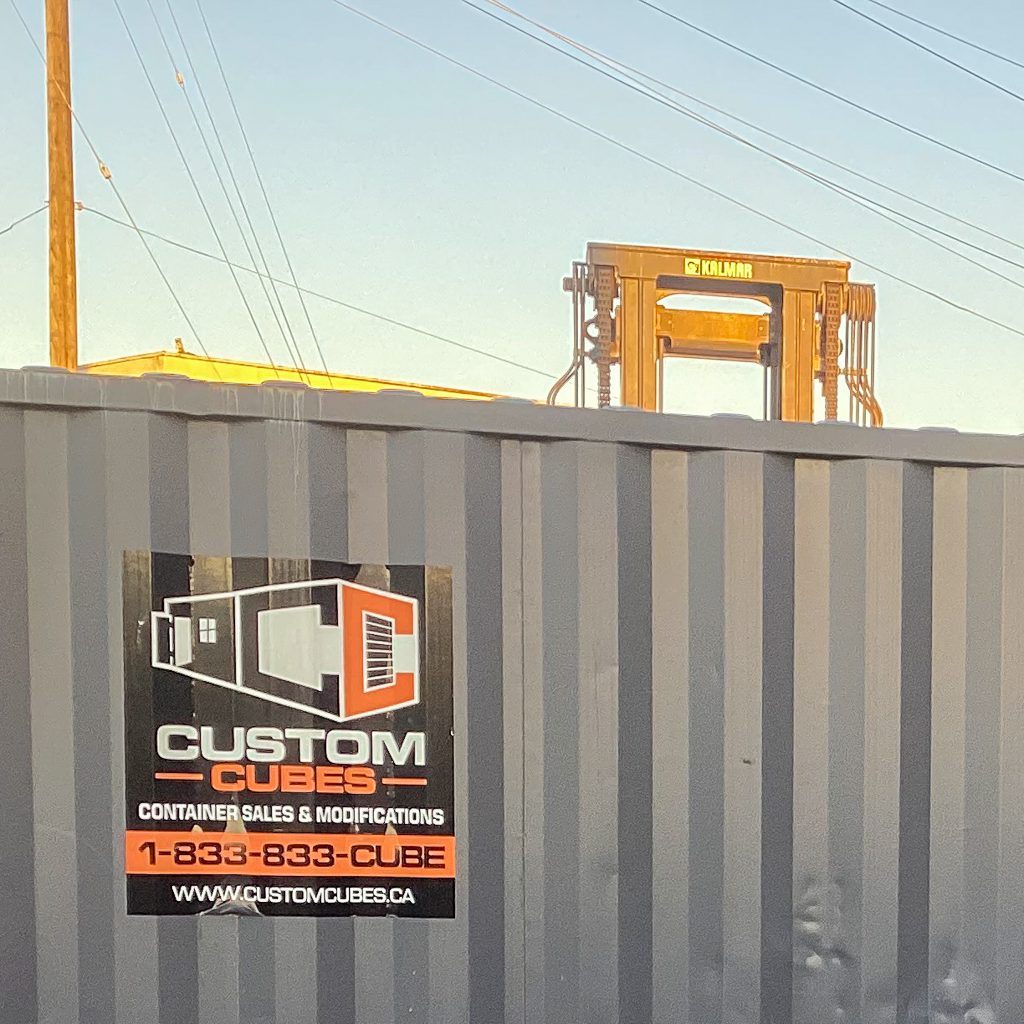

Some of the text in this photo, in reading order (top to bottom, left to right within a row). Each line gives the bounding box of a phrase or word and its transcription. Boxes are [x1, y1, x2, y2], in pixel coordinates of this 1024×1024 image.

[701, 260, 752, 278] KALMAR
[156, 724, 426, 766] CUSTOM
[210, 763, 377, 795] CUBES
[138, 803, 445, 826] CONTAINER SALES & MODIFICATIONS
[138, 842, 446, 869] 1-833-833-CUBE
[171, 885, 416, 904] WWW.CUSTOMCUBES.CA
